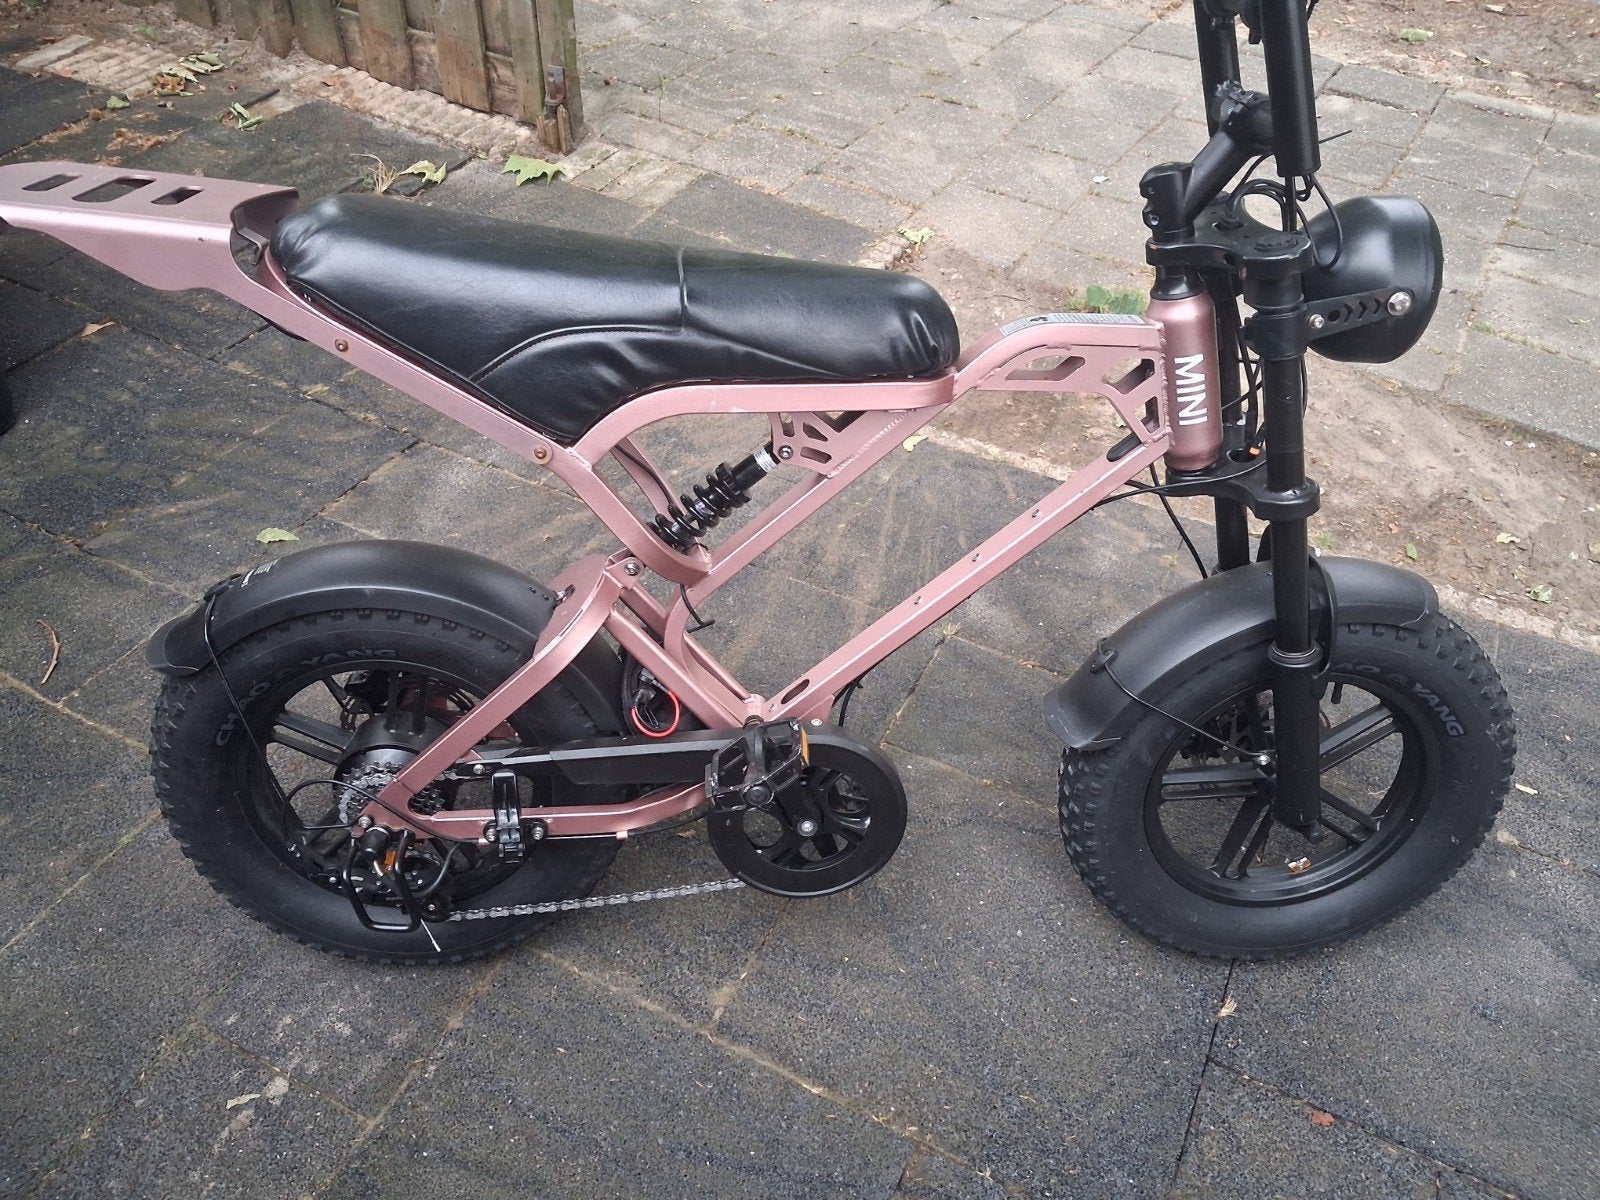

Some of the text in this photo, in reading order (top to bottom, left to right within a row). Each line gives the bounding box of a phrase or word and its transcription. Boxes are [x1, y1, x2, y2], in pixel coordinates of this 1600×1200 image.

[1173, 353, 1208, 426] MINI
[299, 649, 397, 665] YANG
[1411, 682, 1465, 737] YANG
